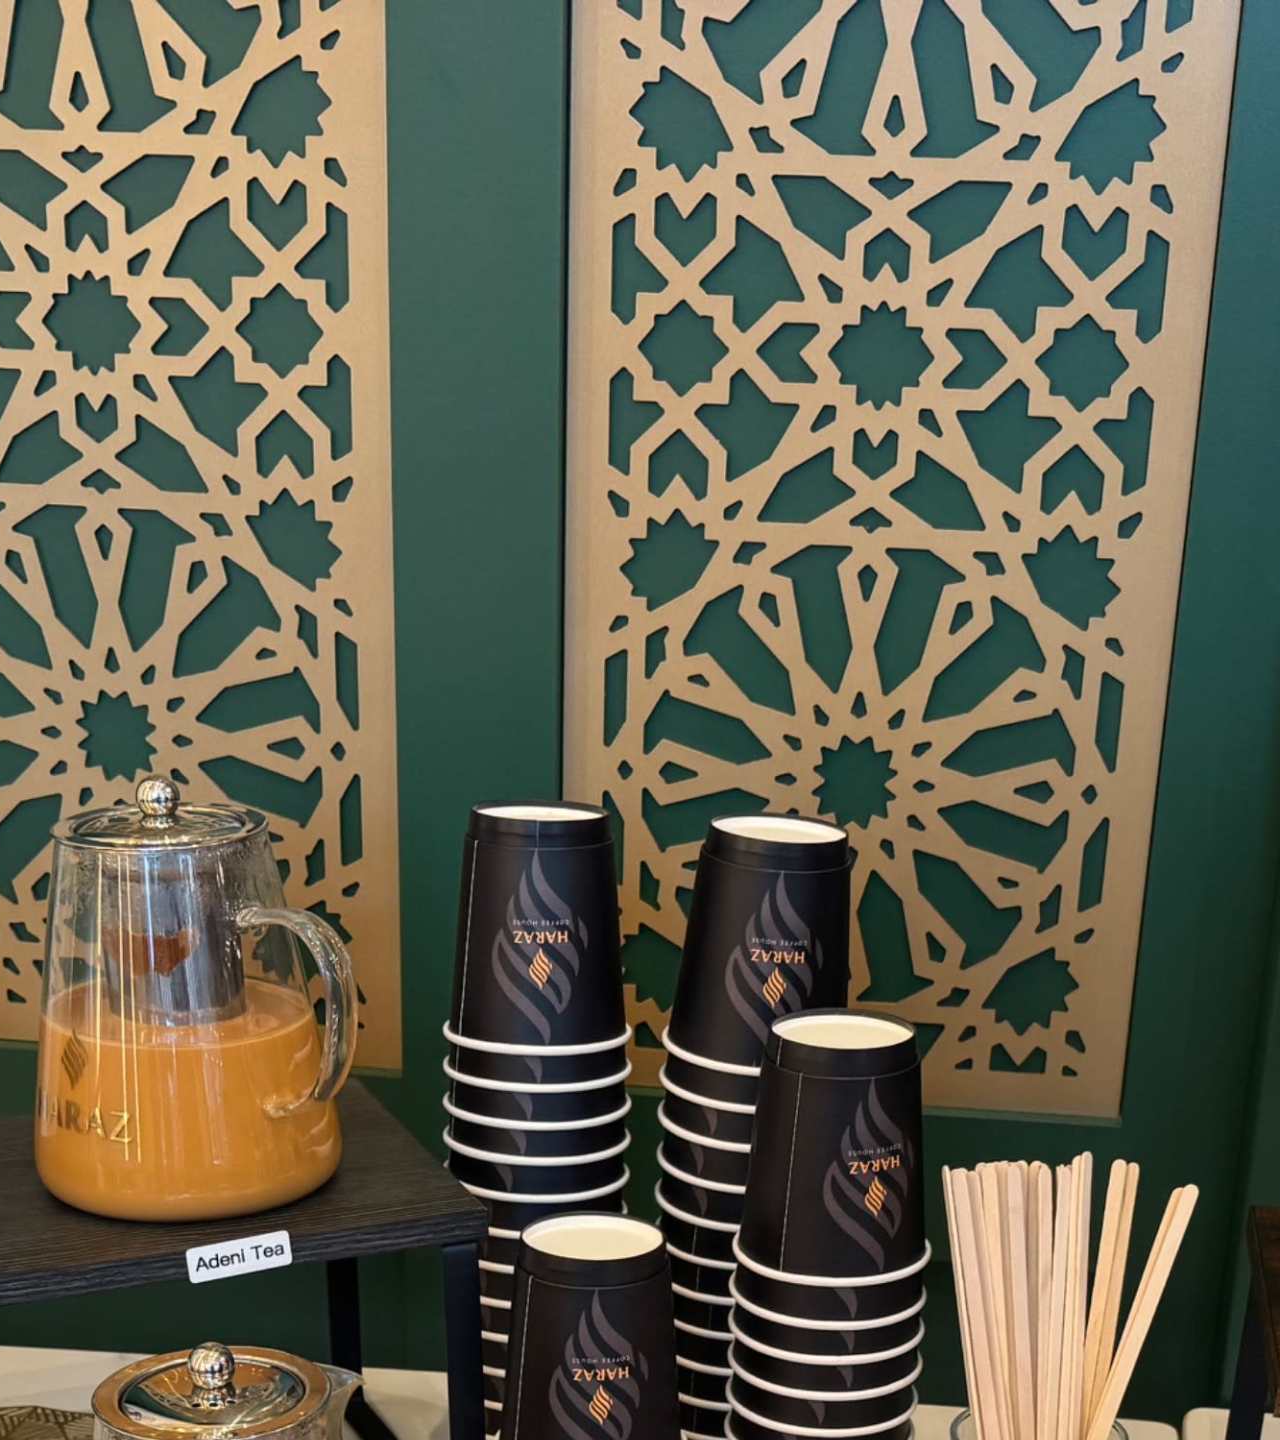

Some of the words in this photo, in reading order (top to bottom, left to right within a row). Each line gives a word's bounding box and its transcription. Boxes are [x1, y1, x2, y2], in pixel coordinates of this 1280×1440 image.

[513, 930, 569, 944] HARAZ
[751, 948, 805, 964] HARAZ
[848, 1154, 900, 1175] HARAZ
[195, 1248, 246, 1273] Adeni
[250, 1244, 285, 1260] Tea
[572, 1366, 629, 1381] HARAZ
